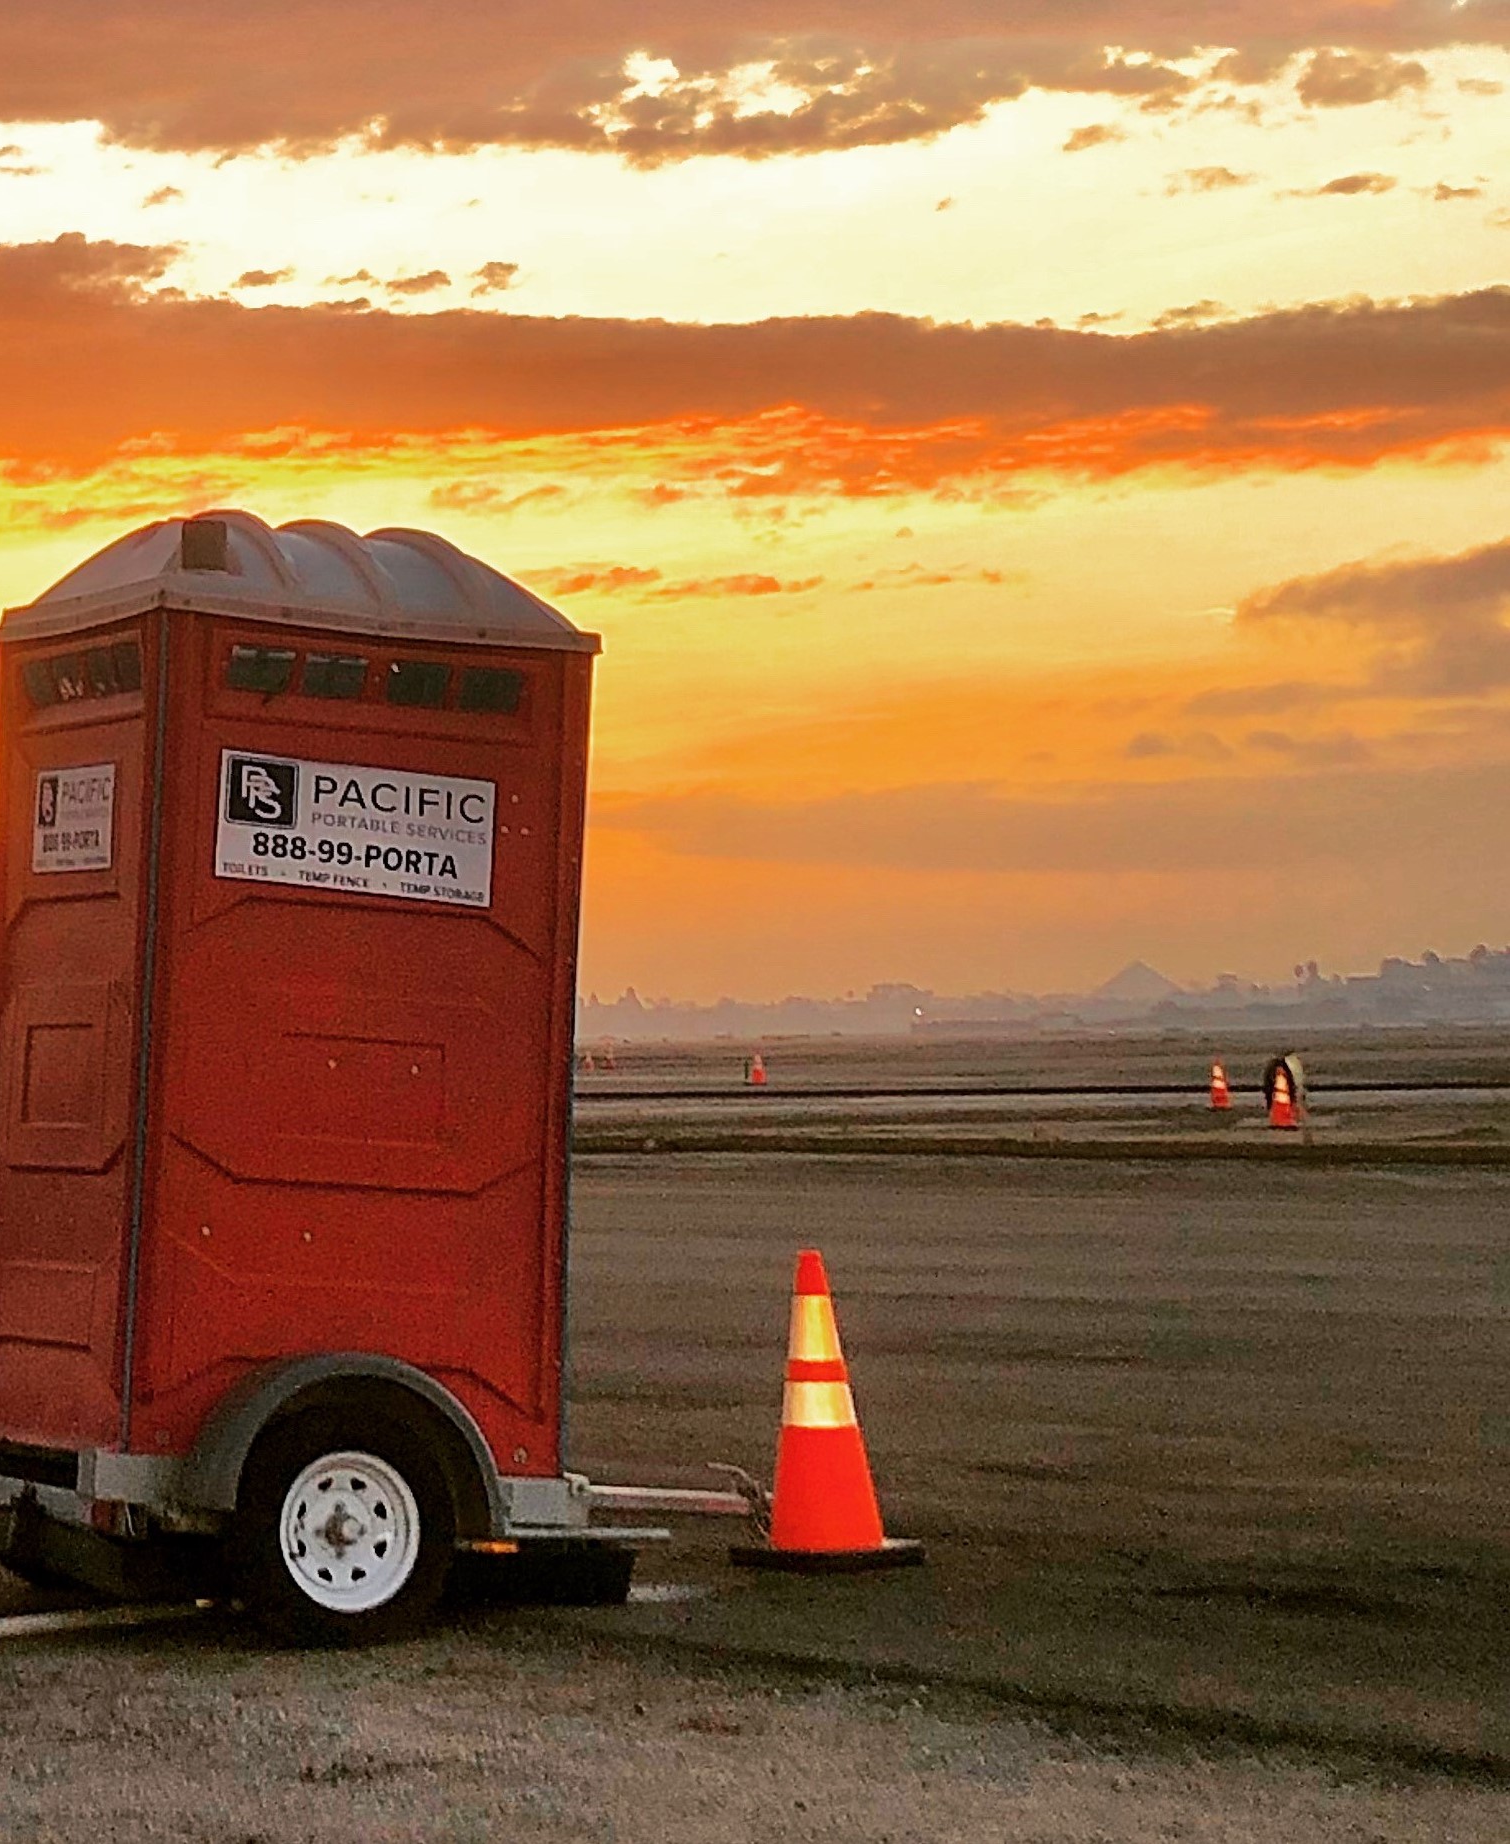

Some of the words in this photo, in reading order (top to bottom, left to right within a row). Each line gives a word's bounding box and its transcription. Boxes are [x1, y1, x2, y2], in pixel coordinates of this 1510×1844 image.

[312, 775, 486, 824] PACIFIC
[310, 811, 400, 835] PORTABLE
[406, 822, 487, 846] SERVICES
[223, 861, 268, 876] TOILETS
[252, 832, 458, 880] 888-99-PORTA
